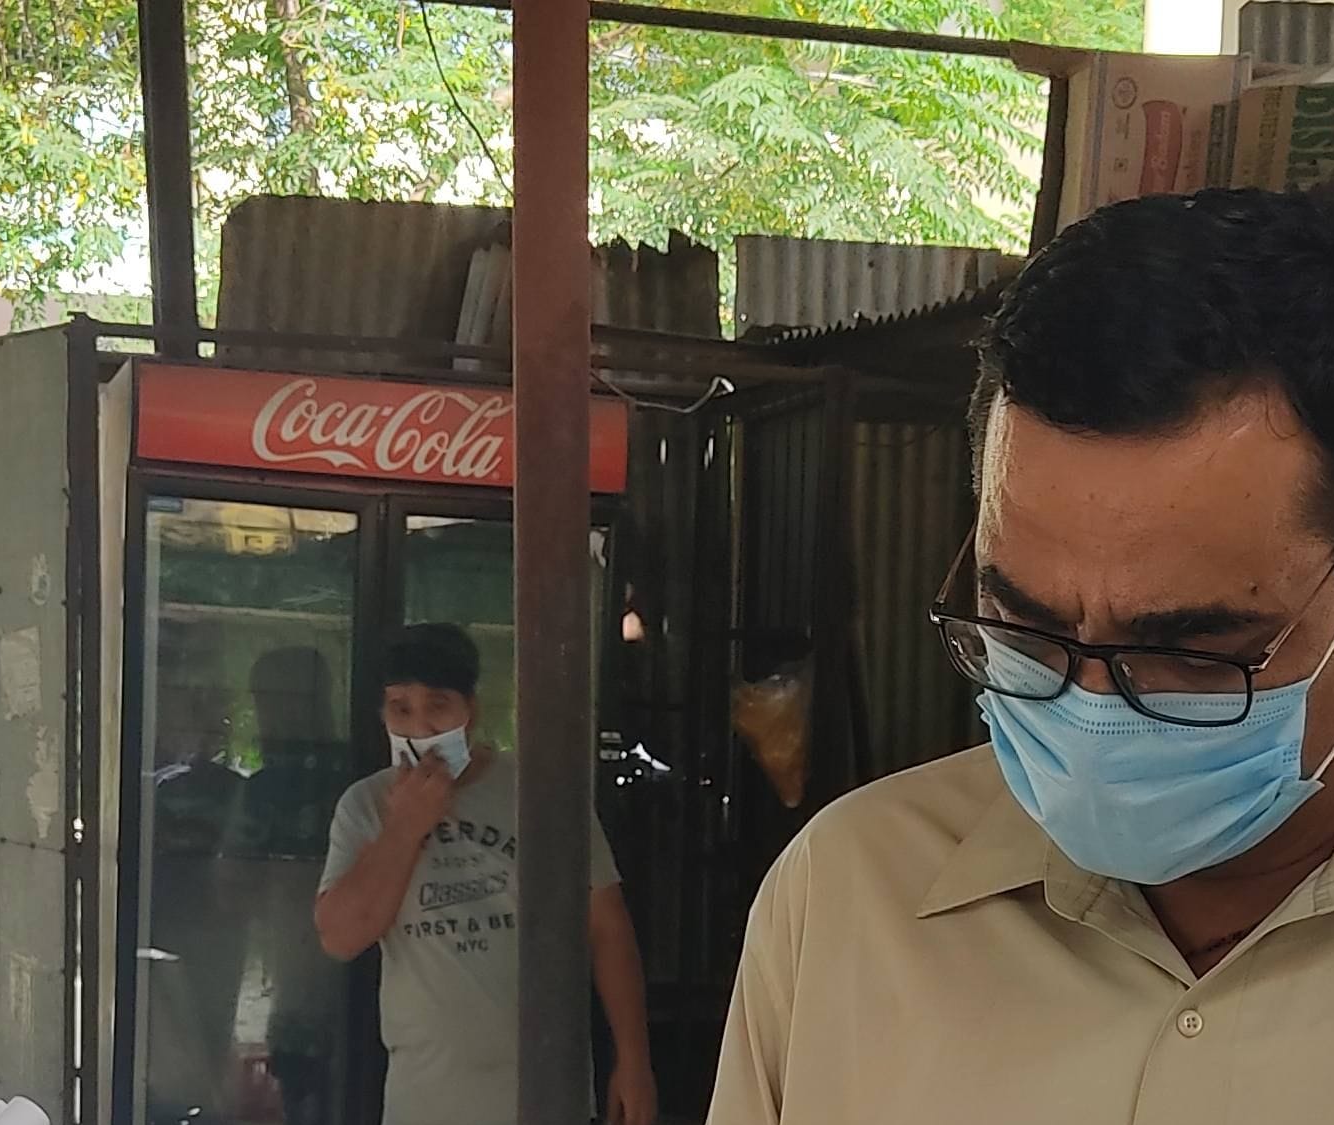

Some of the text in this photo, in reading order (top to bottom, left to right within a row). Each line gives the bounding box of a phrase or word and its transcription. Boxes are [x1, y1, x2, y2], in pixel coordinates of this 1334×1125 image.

[252, 378, 514, 479] Coca-Cola
[404, 919, 458, 938] FIRST
[488, 913, 516, 930] BE
[456, 938, 488, 952] NYC
